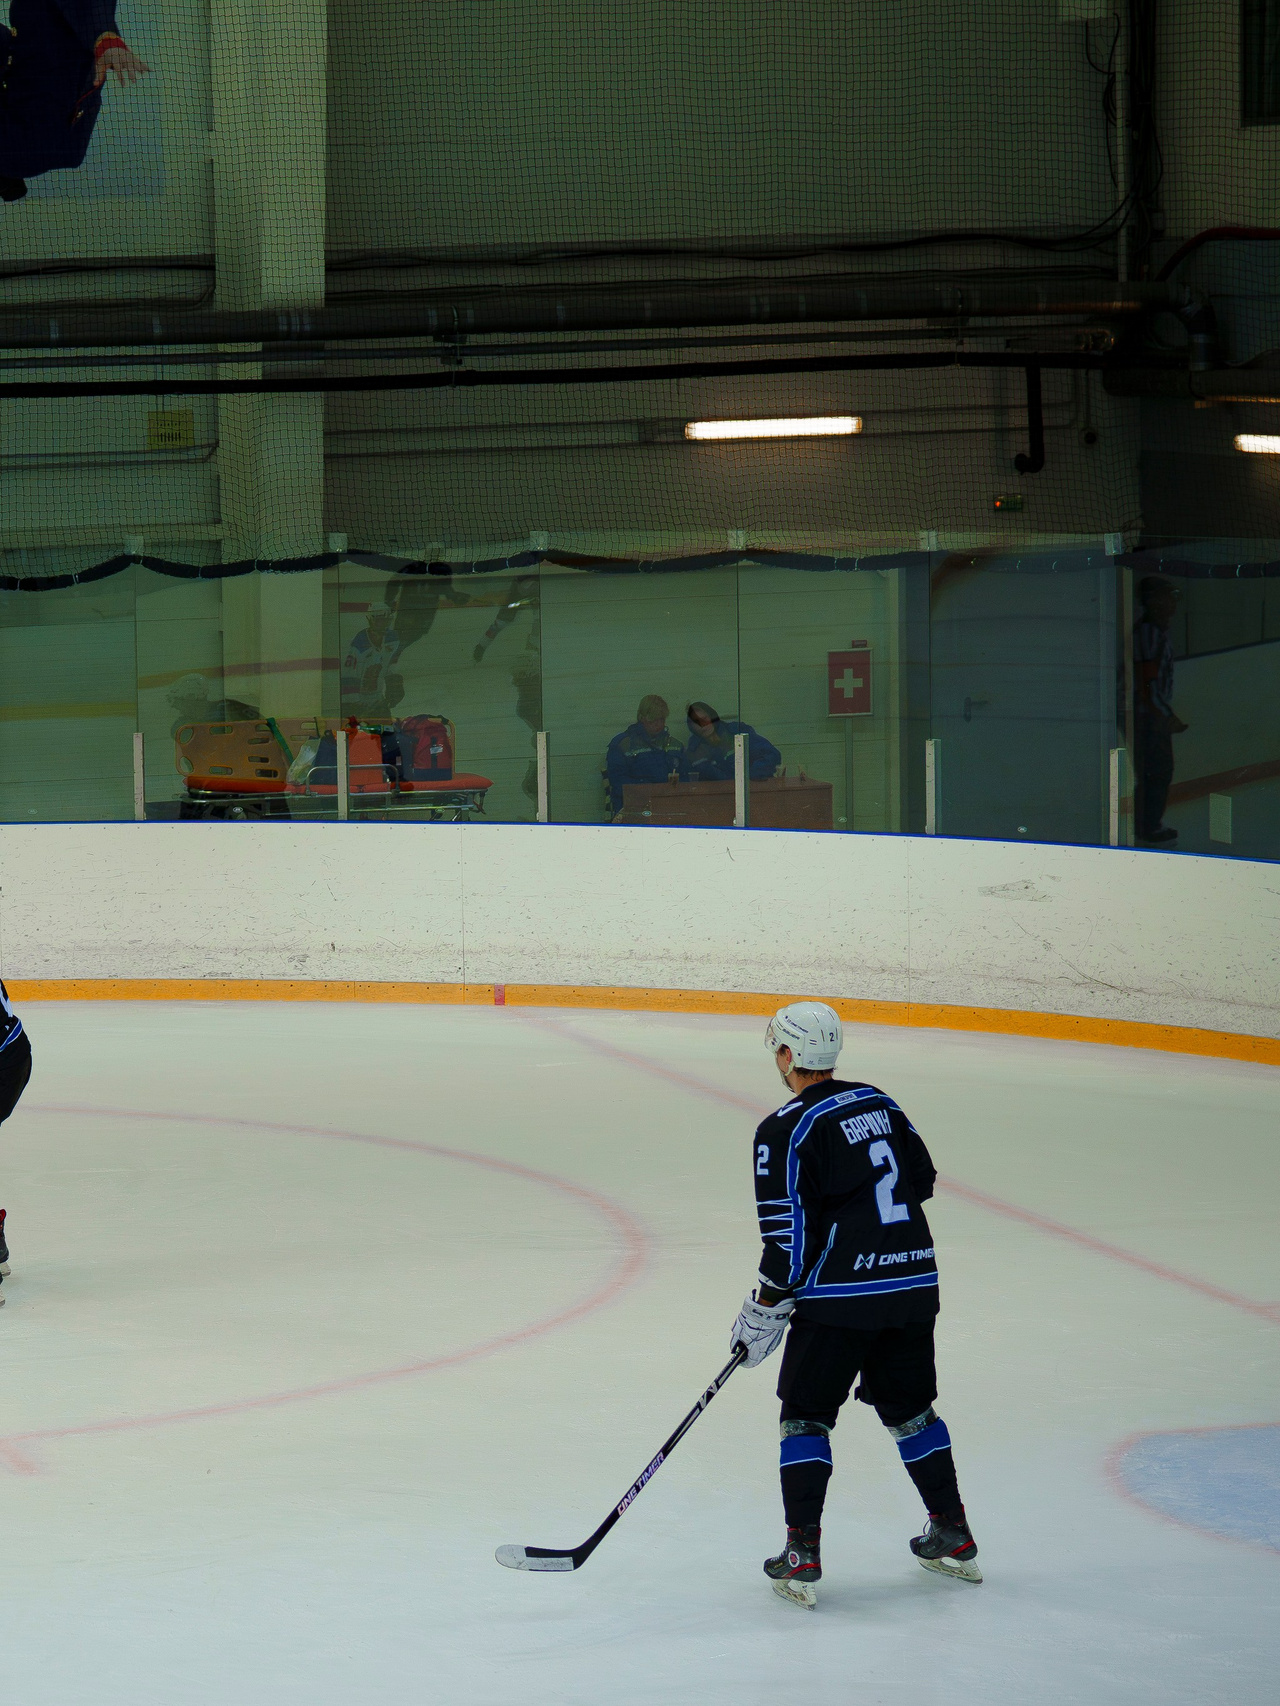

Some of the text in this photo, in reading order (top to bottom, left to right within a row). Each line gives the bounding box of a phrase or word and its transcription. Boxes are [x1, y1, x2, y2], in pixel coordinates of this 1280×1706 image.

[828, 1032, 835, 1042] 2
[839, 1109, 893, 1145] БАРМИН
[756, 1144, 770, 1176] 2
[868, 1139, 910, 1225] 2
[878, 1252, 908, 1266] ONE
[616, 1452, 665, 1517] ONE TIMER
